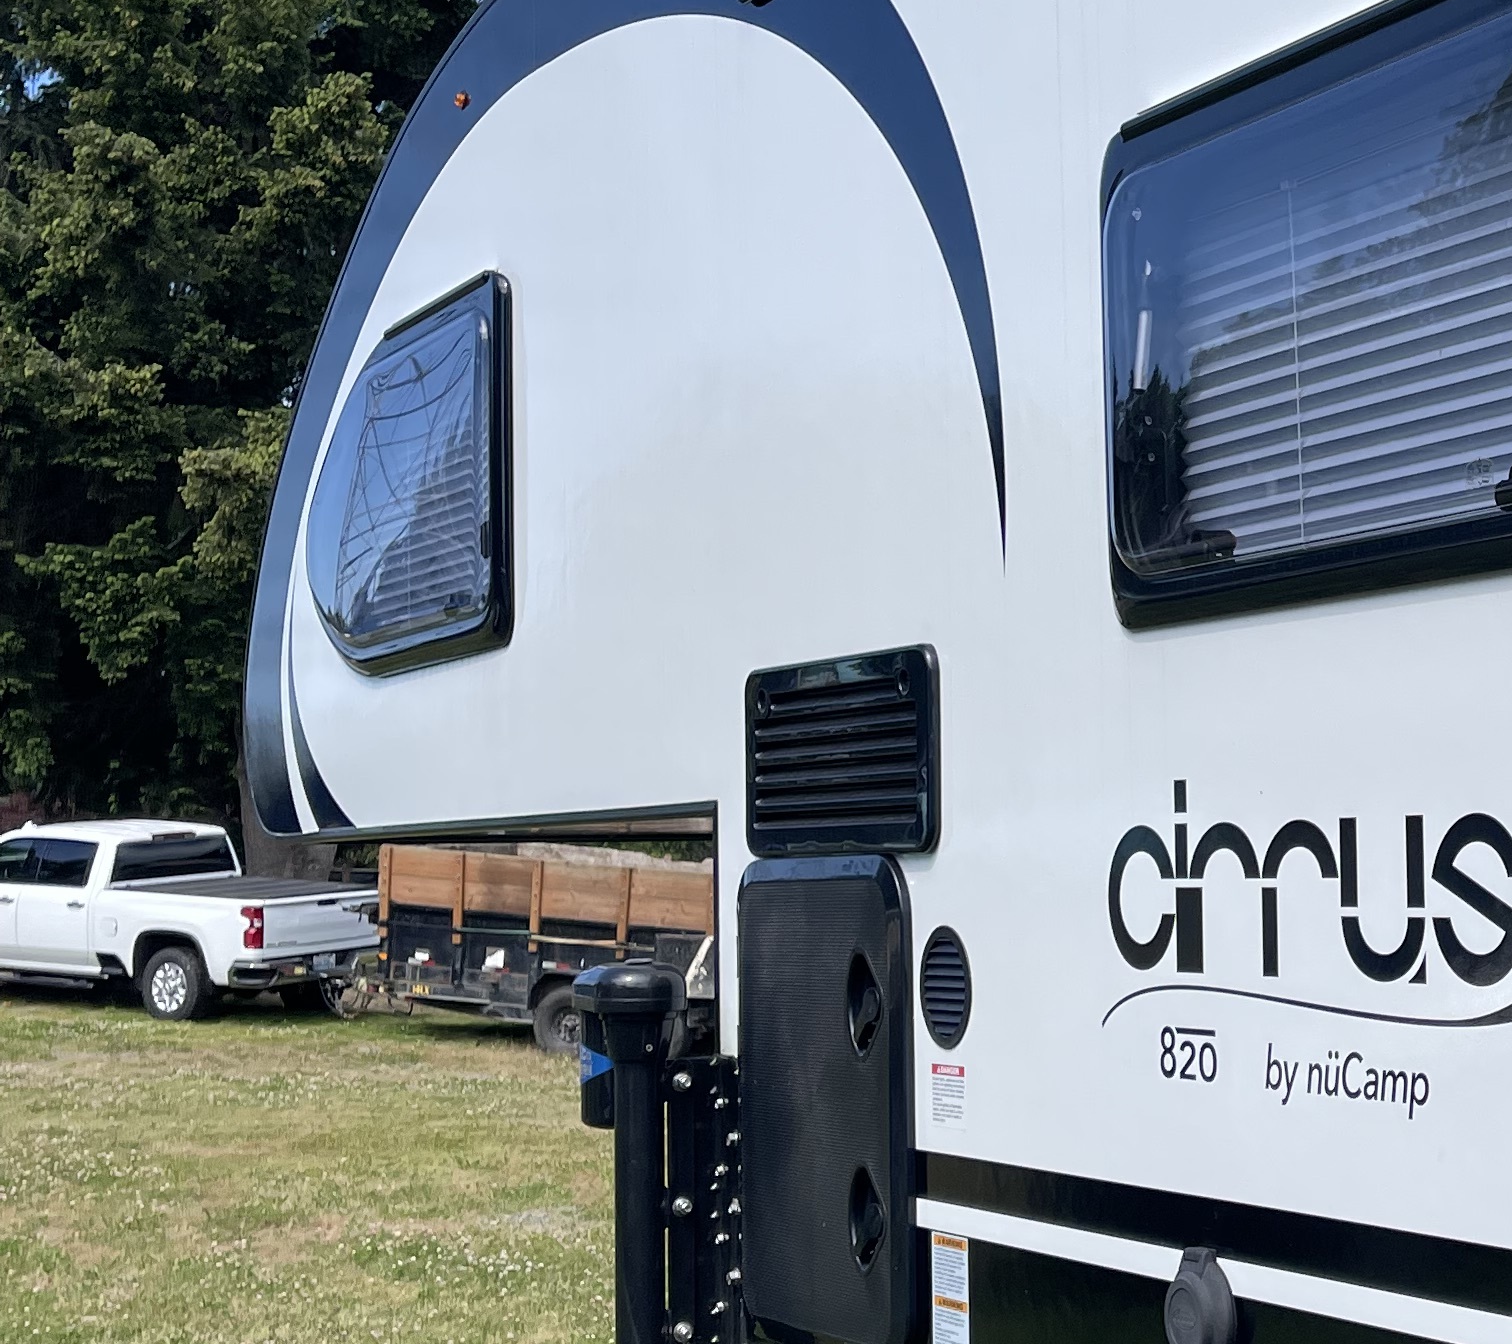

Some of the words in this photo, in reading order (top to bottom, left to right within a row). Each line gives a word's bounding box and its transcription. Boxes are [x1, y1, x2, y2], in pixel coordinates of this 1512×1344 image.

[1160, 1026, 1217, 1083] 820
[1265, 1043, 1298, 1105] by
[1307, 1051, 1430, 1120] nüCamp
